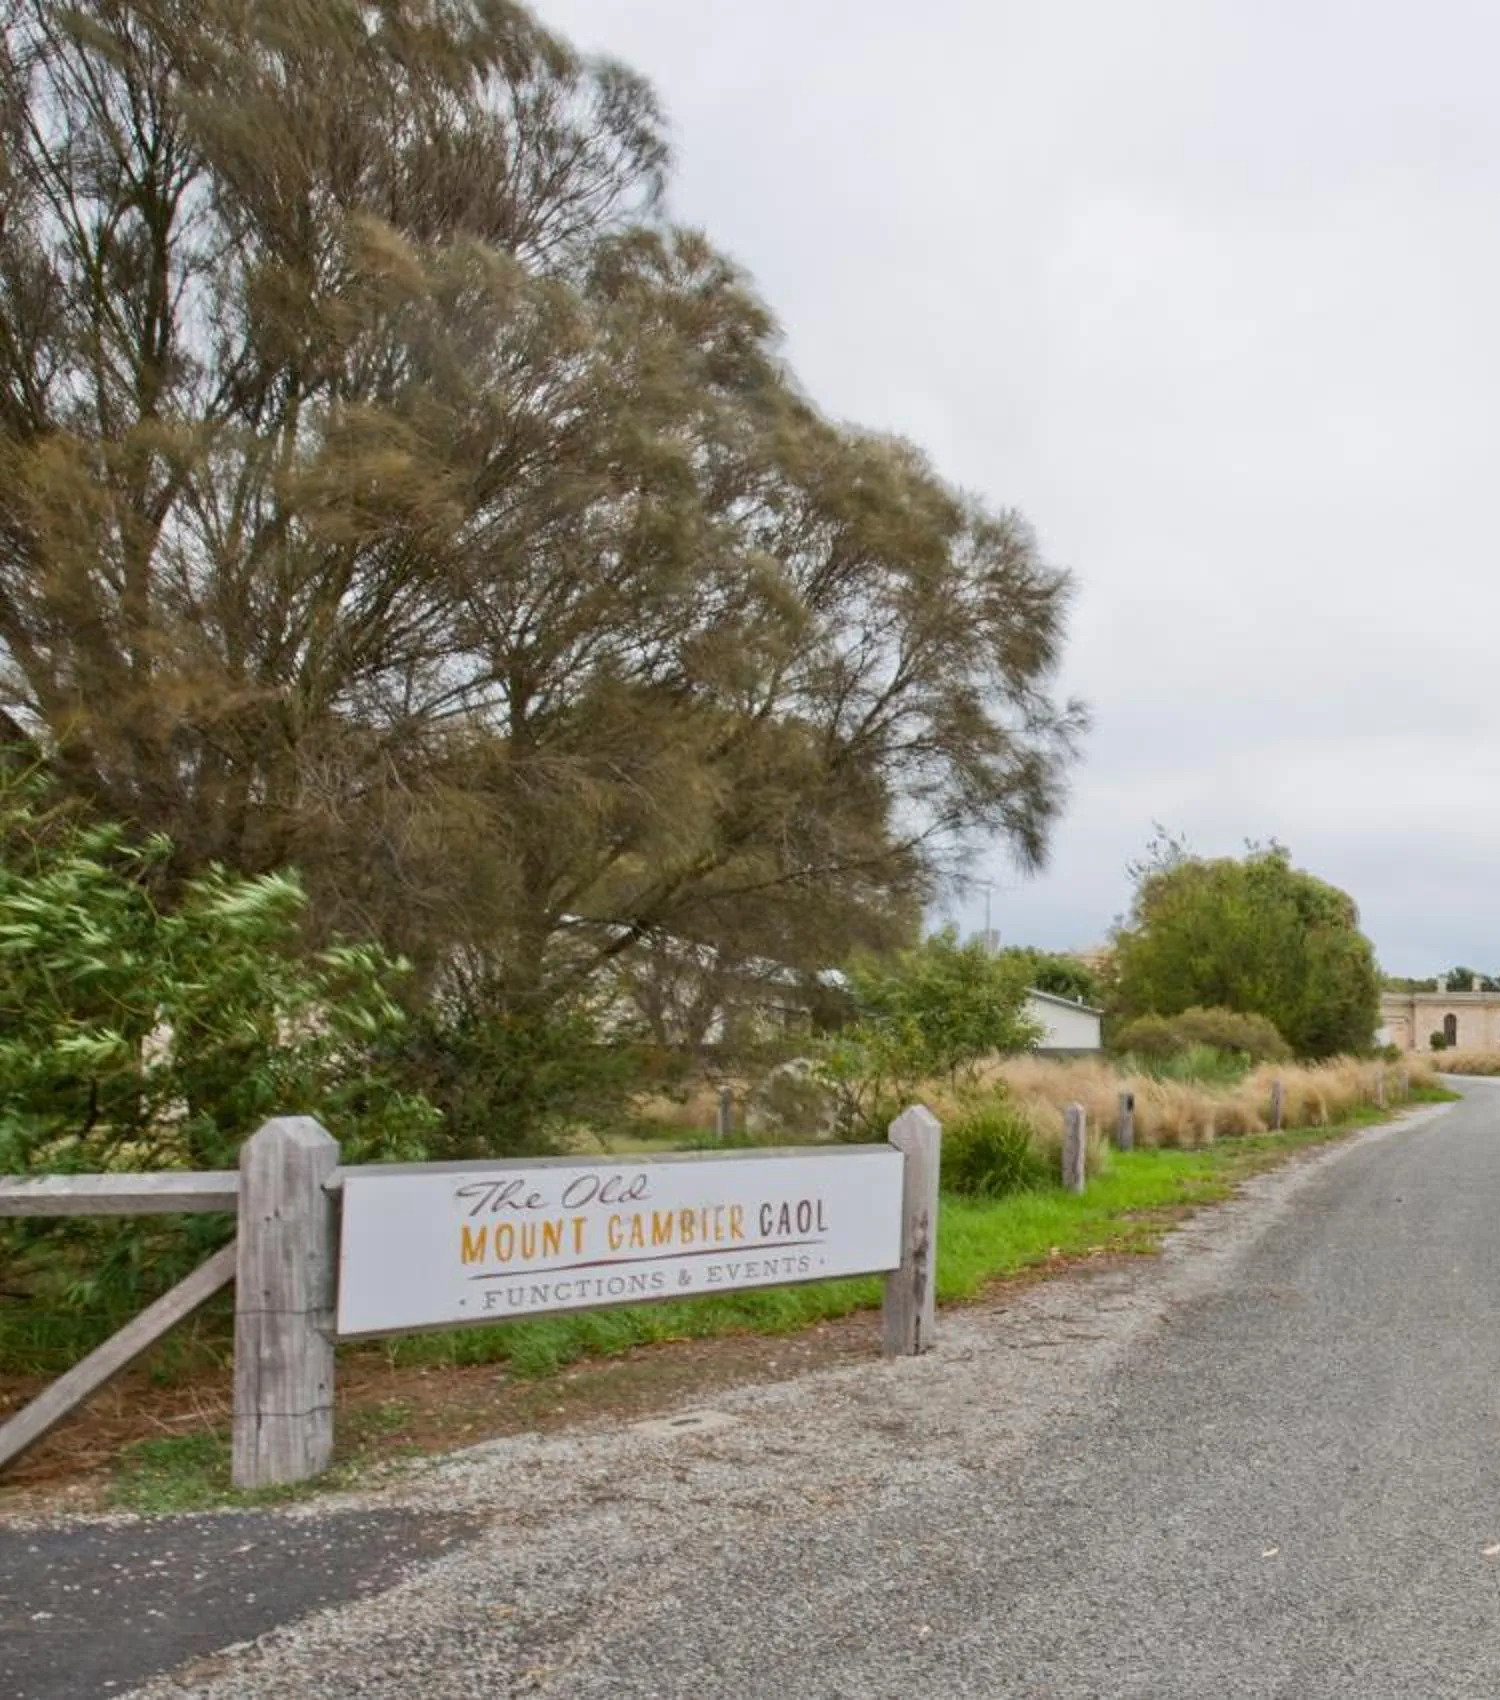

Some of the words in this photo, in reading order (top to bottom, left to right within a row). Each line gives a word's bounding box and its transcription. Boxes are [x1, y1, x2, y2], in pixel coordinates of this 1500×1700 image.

[455, 1181, 544, 1217] The
[562, 1174, 651, 1209] Old
[460, 1216, 588, 1265] MOUNT
[607, 1205, 745, 1251] GAMBIER
[759, 1199, 829, 1237] GAOL
[483, 1271, 666, 1309] FUNCTIONS
[678, 1267, 692, 1284] &
[707, 1255, 810, 1283] EVENTS
